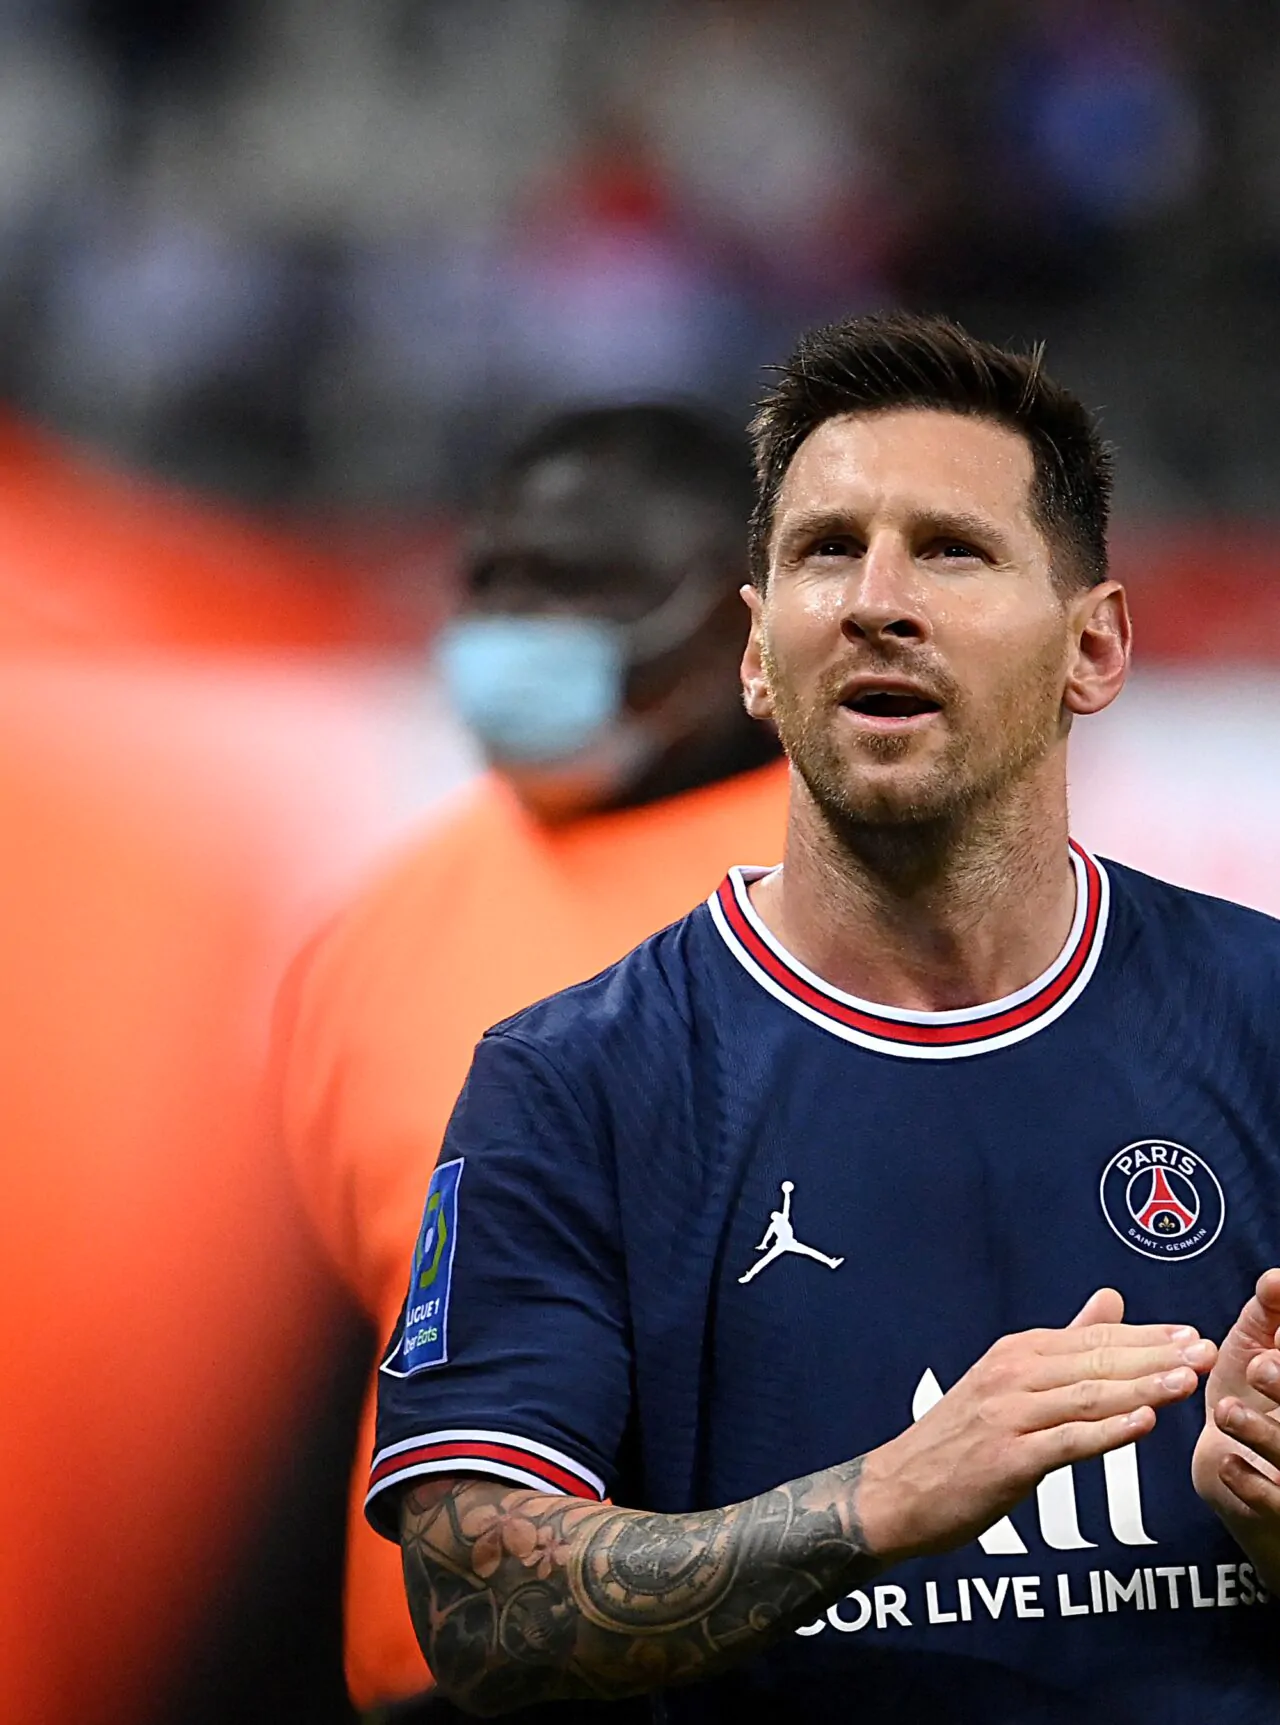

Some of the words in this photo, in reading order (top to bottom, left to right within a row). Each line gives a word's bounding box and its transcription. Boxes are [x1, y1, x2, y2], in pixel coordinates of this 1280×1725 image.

[1116, 1146, 1197, 1176] PARIS
[406, 1300, 434, 1328] LIGUE
[434, 1297, 440, 1315] 1
[925, 1576, 1044, 1624] LIVE
